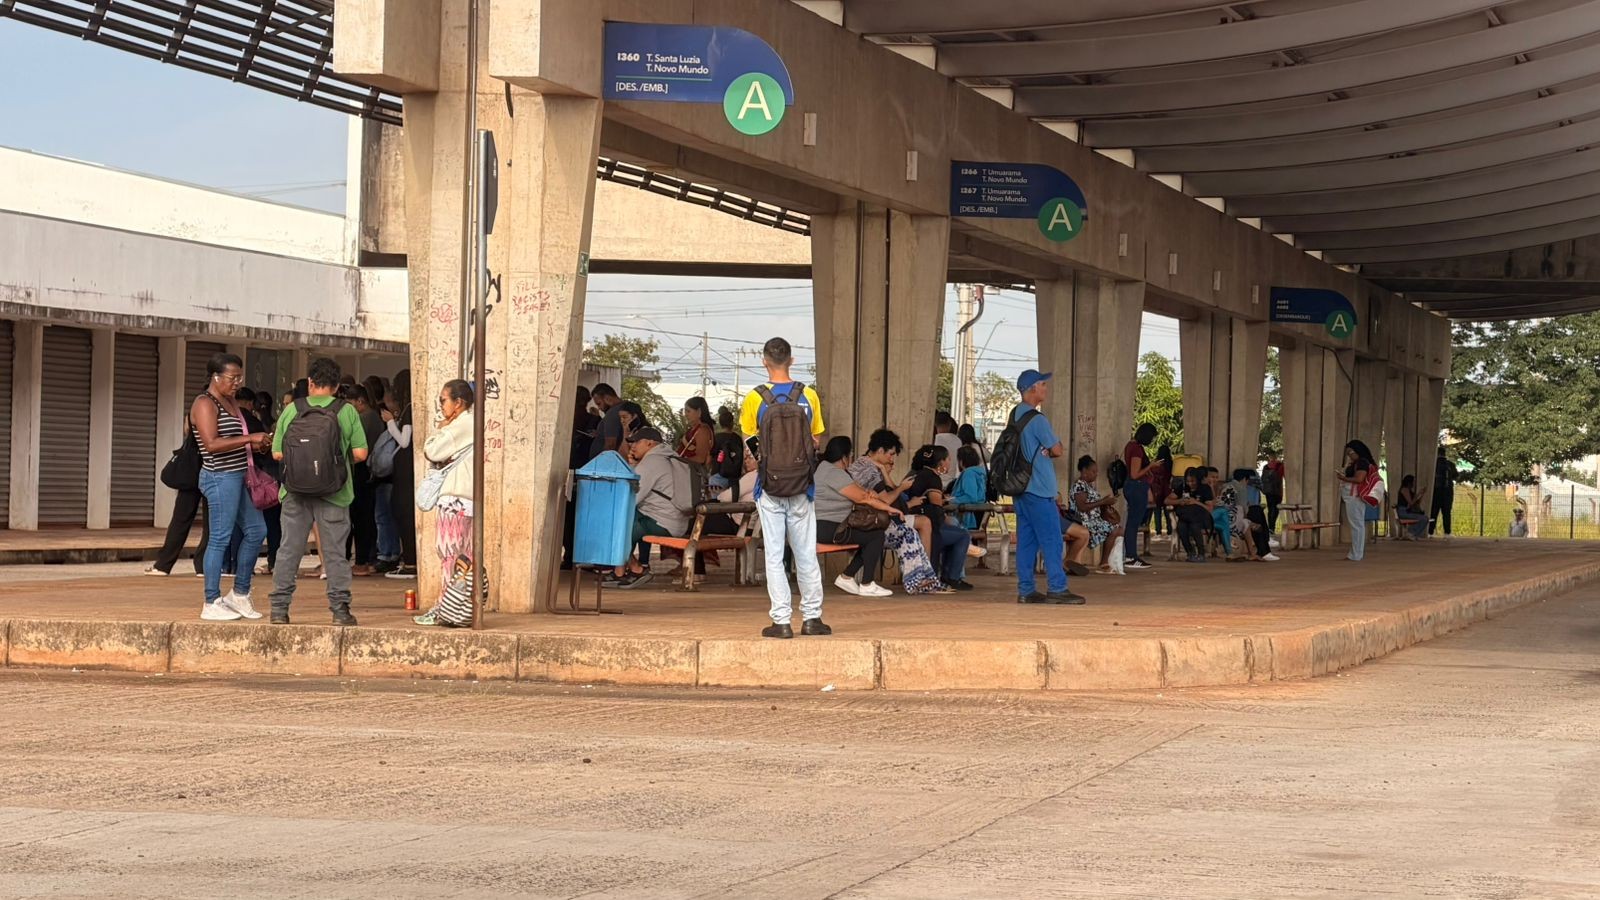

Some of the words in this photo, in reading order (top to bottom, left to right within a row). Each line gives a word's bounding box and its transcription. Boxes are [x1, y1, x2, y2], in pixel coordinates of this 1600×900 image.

[646, 53, 654, 62] T.
[655, 54, 678, 64] Santa
[679, 55, 700, 64] Luzia
[646, 64, 653, 73] T.
[654, 64, 677, 73] Novo
[678, 65, 709, 75] Mundo
[737, 80, 773, 120] A
[1005, 176, 1028, 184] Mundo
[1047, 203, 1073, 232] A
[1331, 313, 1348, 333] A
